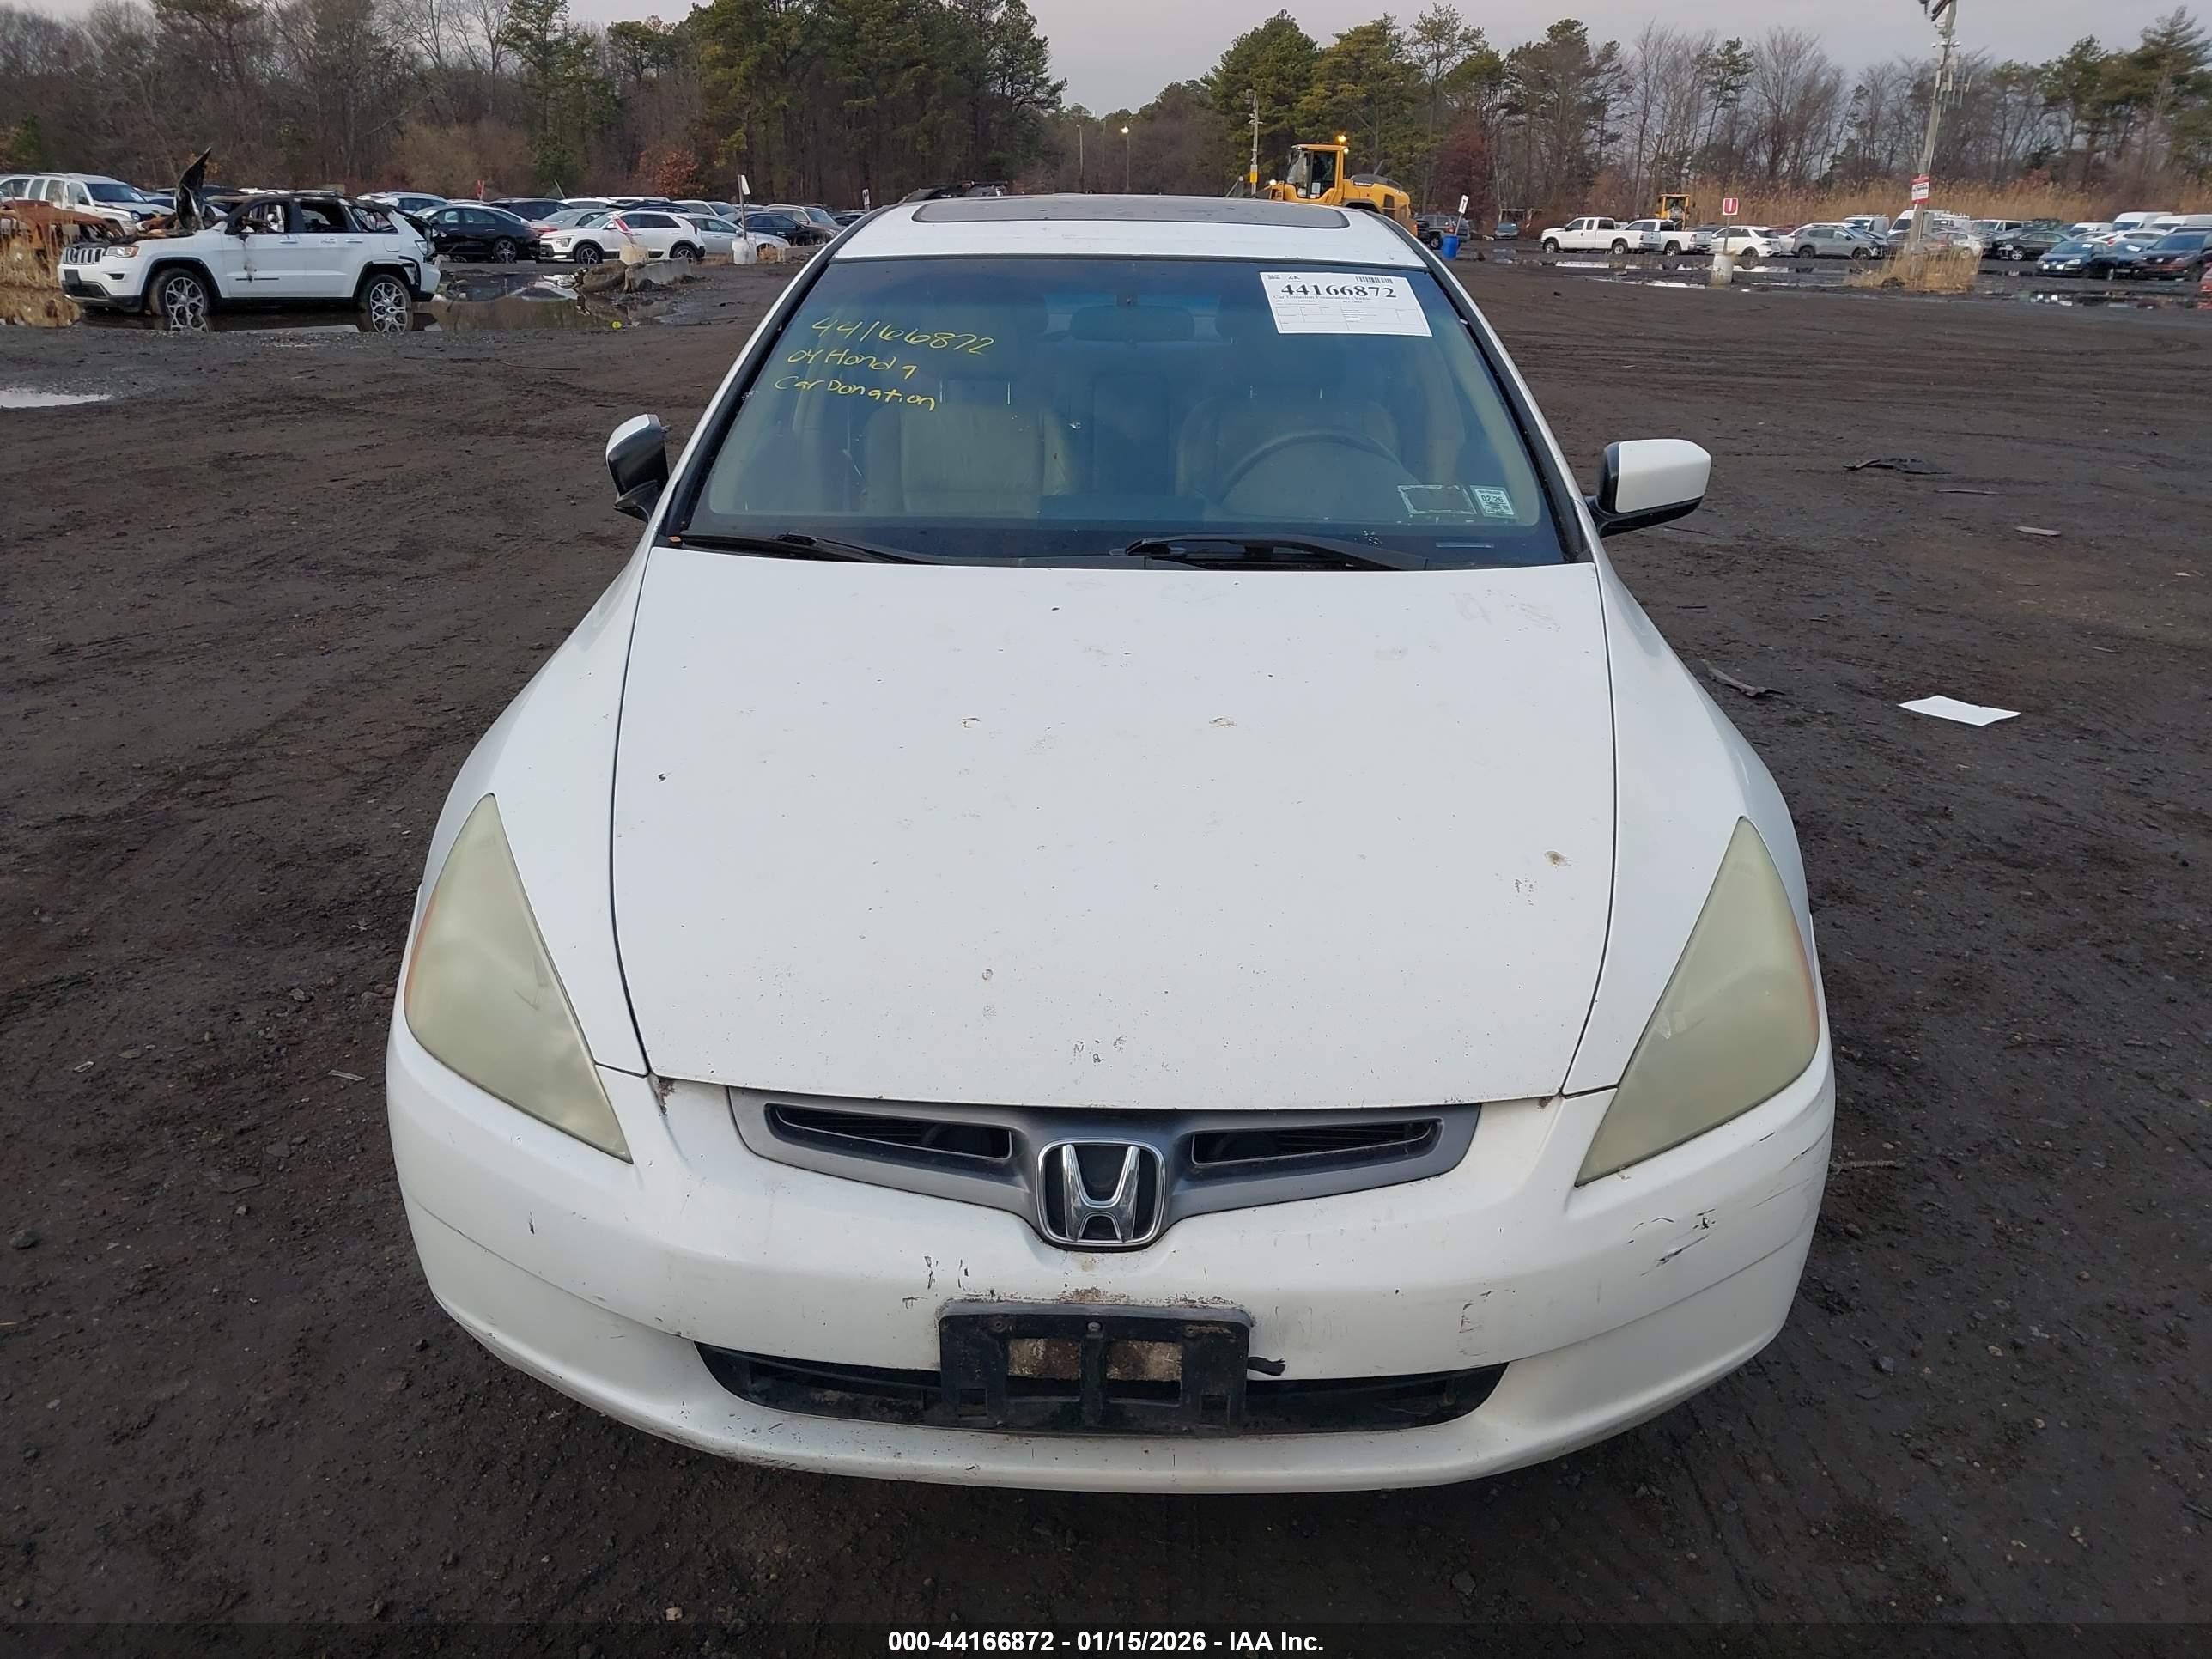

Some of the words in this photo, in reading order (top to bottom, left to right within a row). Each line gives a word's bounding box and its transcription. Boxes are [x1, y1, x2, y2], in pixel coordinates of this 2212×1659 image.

[1281, 284, 1397, 298] 44166872
[811, 317, 994, 356] 44166872
[775, 376, 825, 390] Car
[827, 380, 935, 410] Donation
